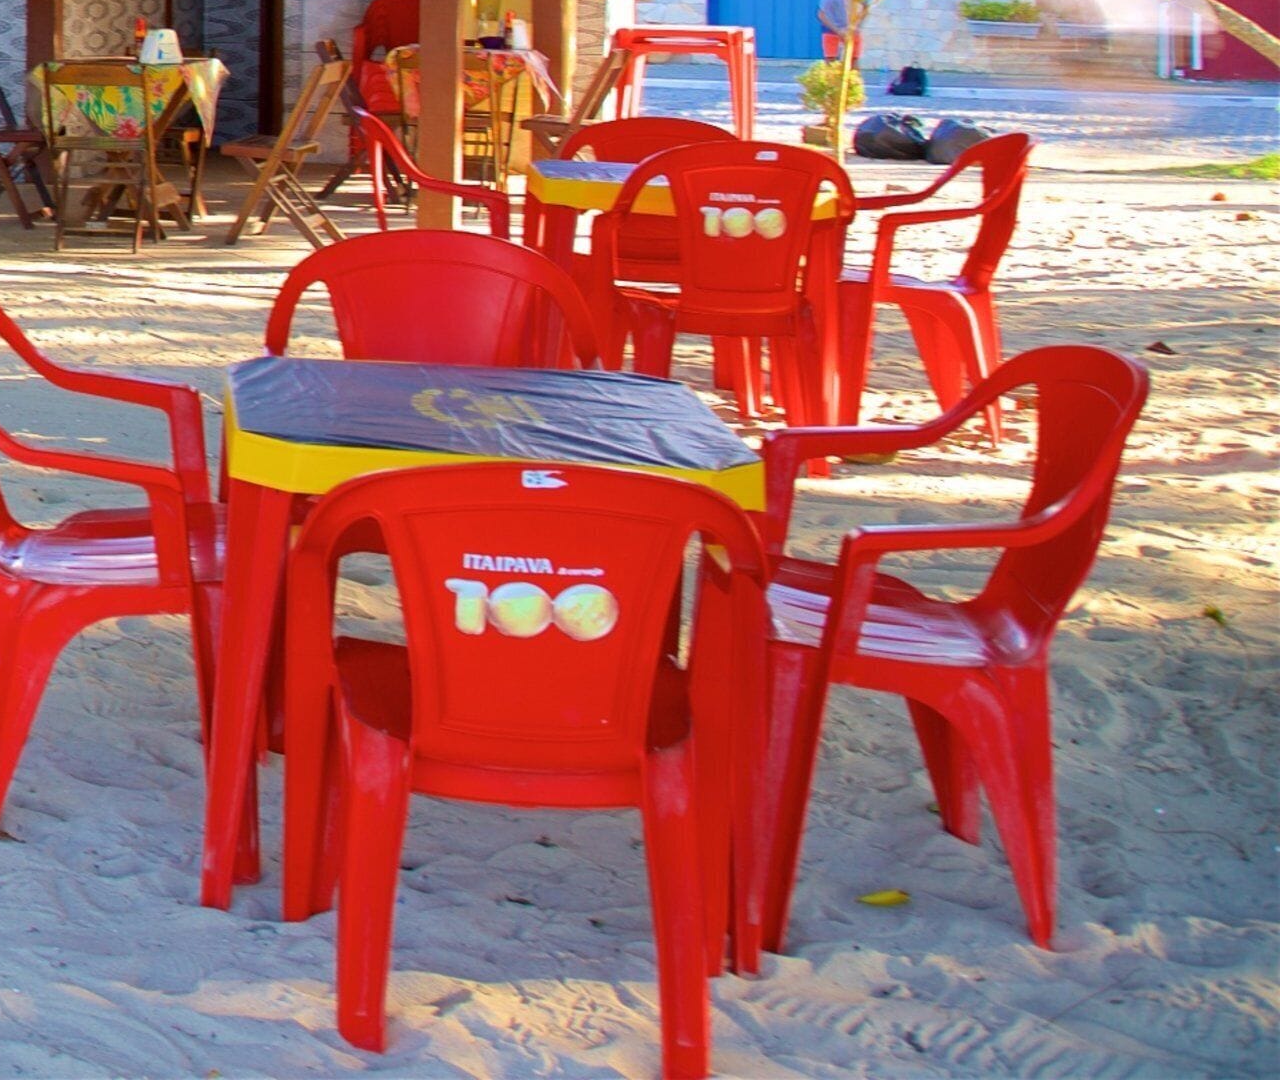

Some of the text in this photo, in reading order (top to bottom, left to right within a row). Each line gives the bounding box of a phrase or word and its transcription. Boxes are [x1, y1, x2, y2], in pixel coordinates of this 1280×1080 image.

[700, 206, 787, 239] 100
[462, 552, 555, 574] ITAIPAVA
[444, 578, 622, 642] 100
